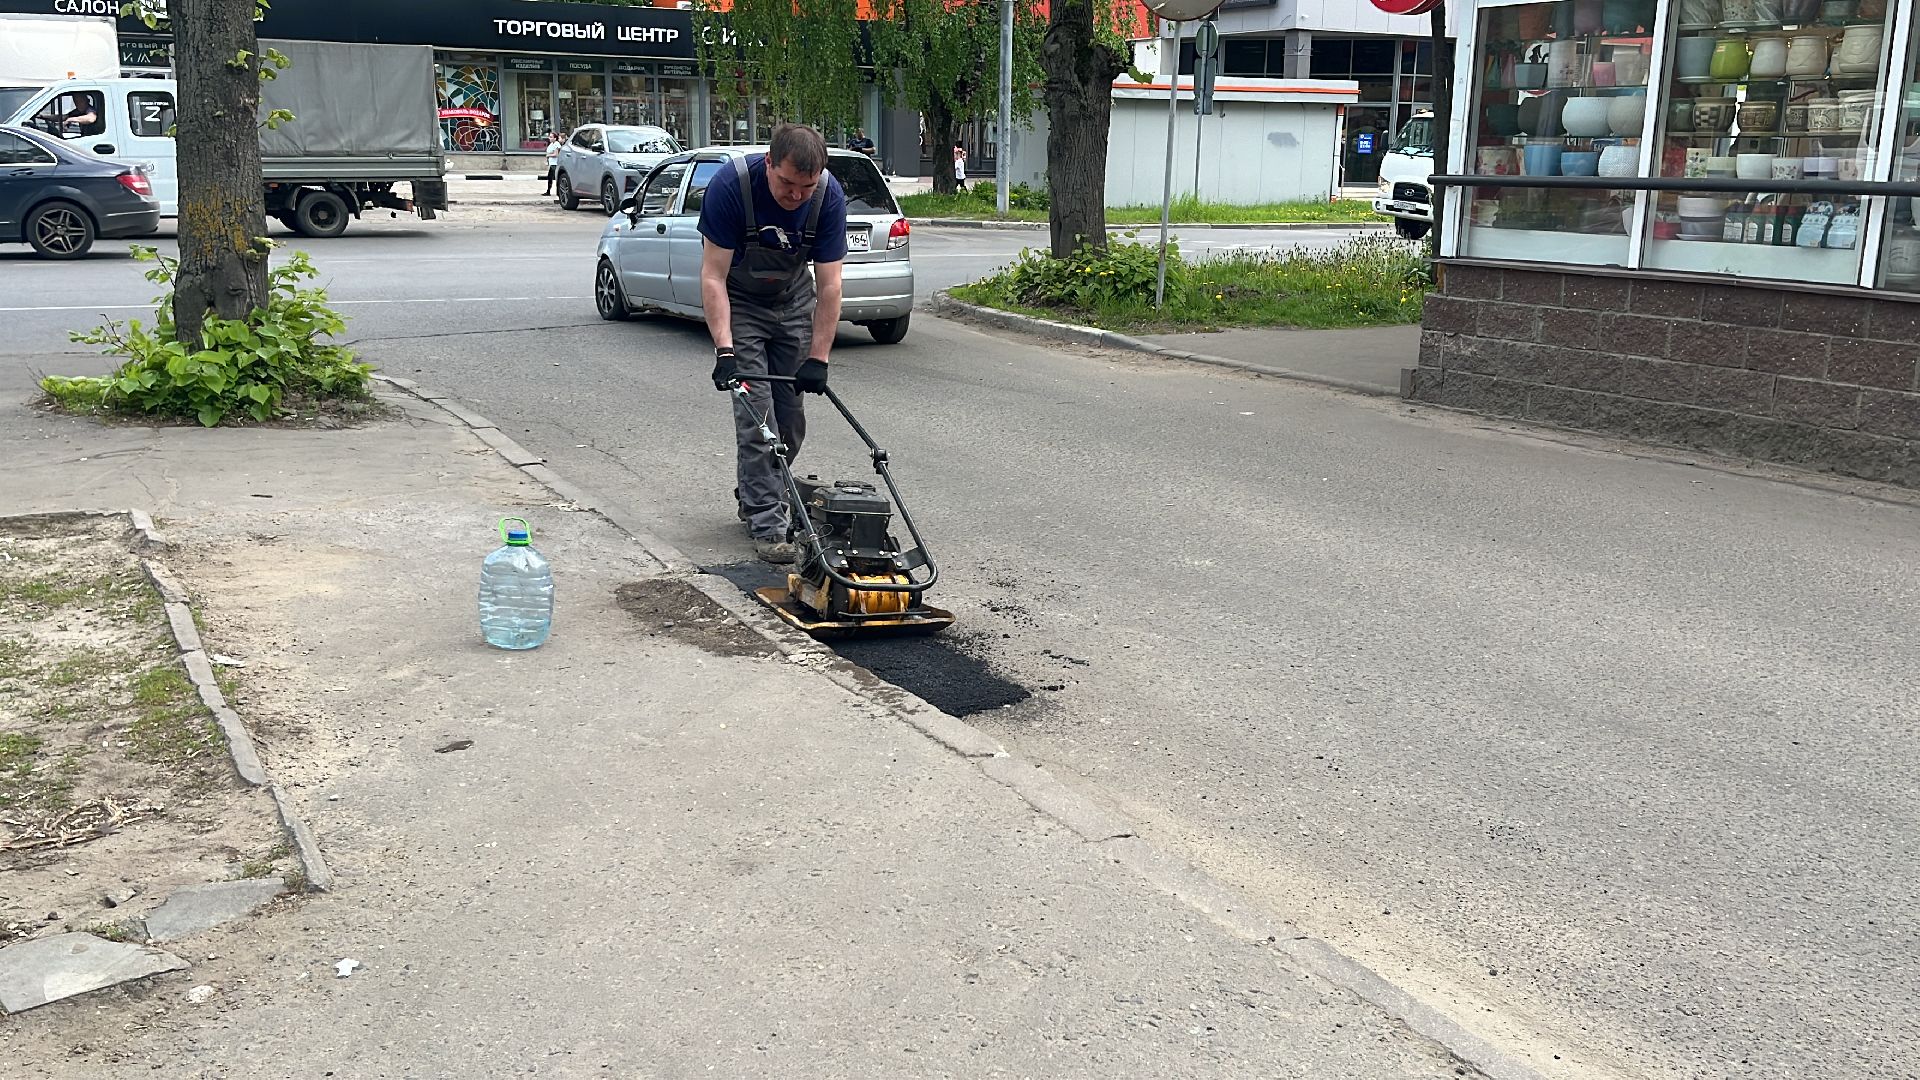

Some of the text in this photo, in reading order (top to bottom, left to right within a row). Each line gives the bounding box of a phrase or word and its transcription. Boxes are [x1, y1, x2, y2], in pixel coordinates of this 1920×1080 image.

[54, 0, 120, 14] САЛОН
[493, 19, 605, 40] ТОРГОВЫЙ
[617, 25, 679, 43] ЦЕНТР
[144, 106, 161, 121] Z
[849, 234, 867, 244] 164
